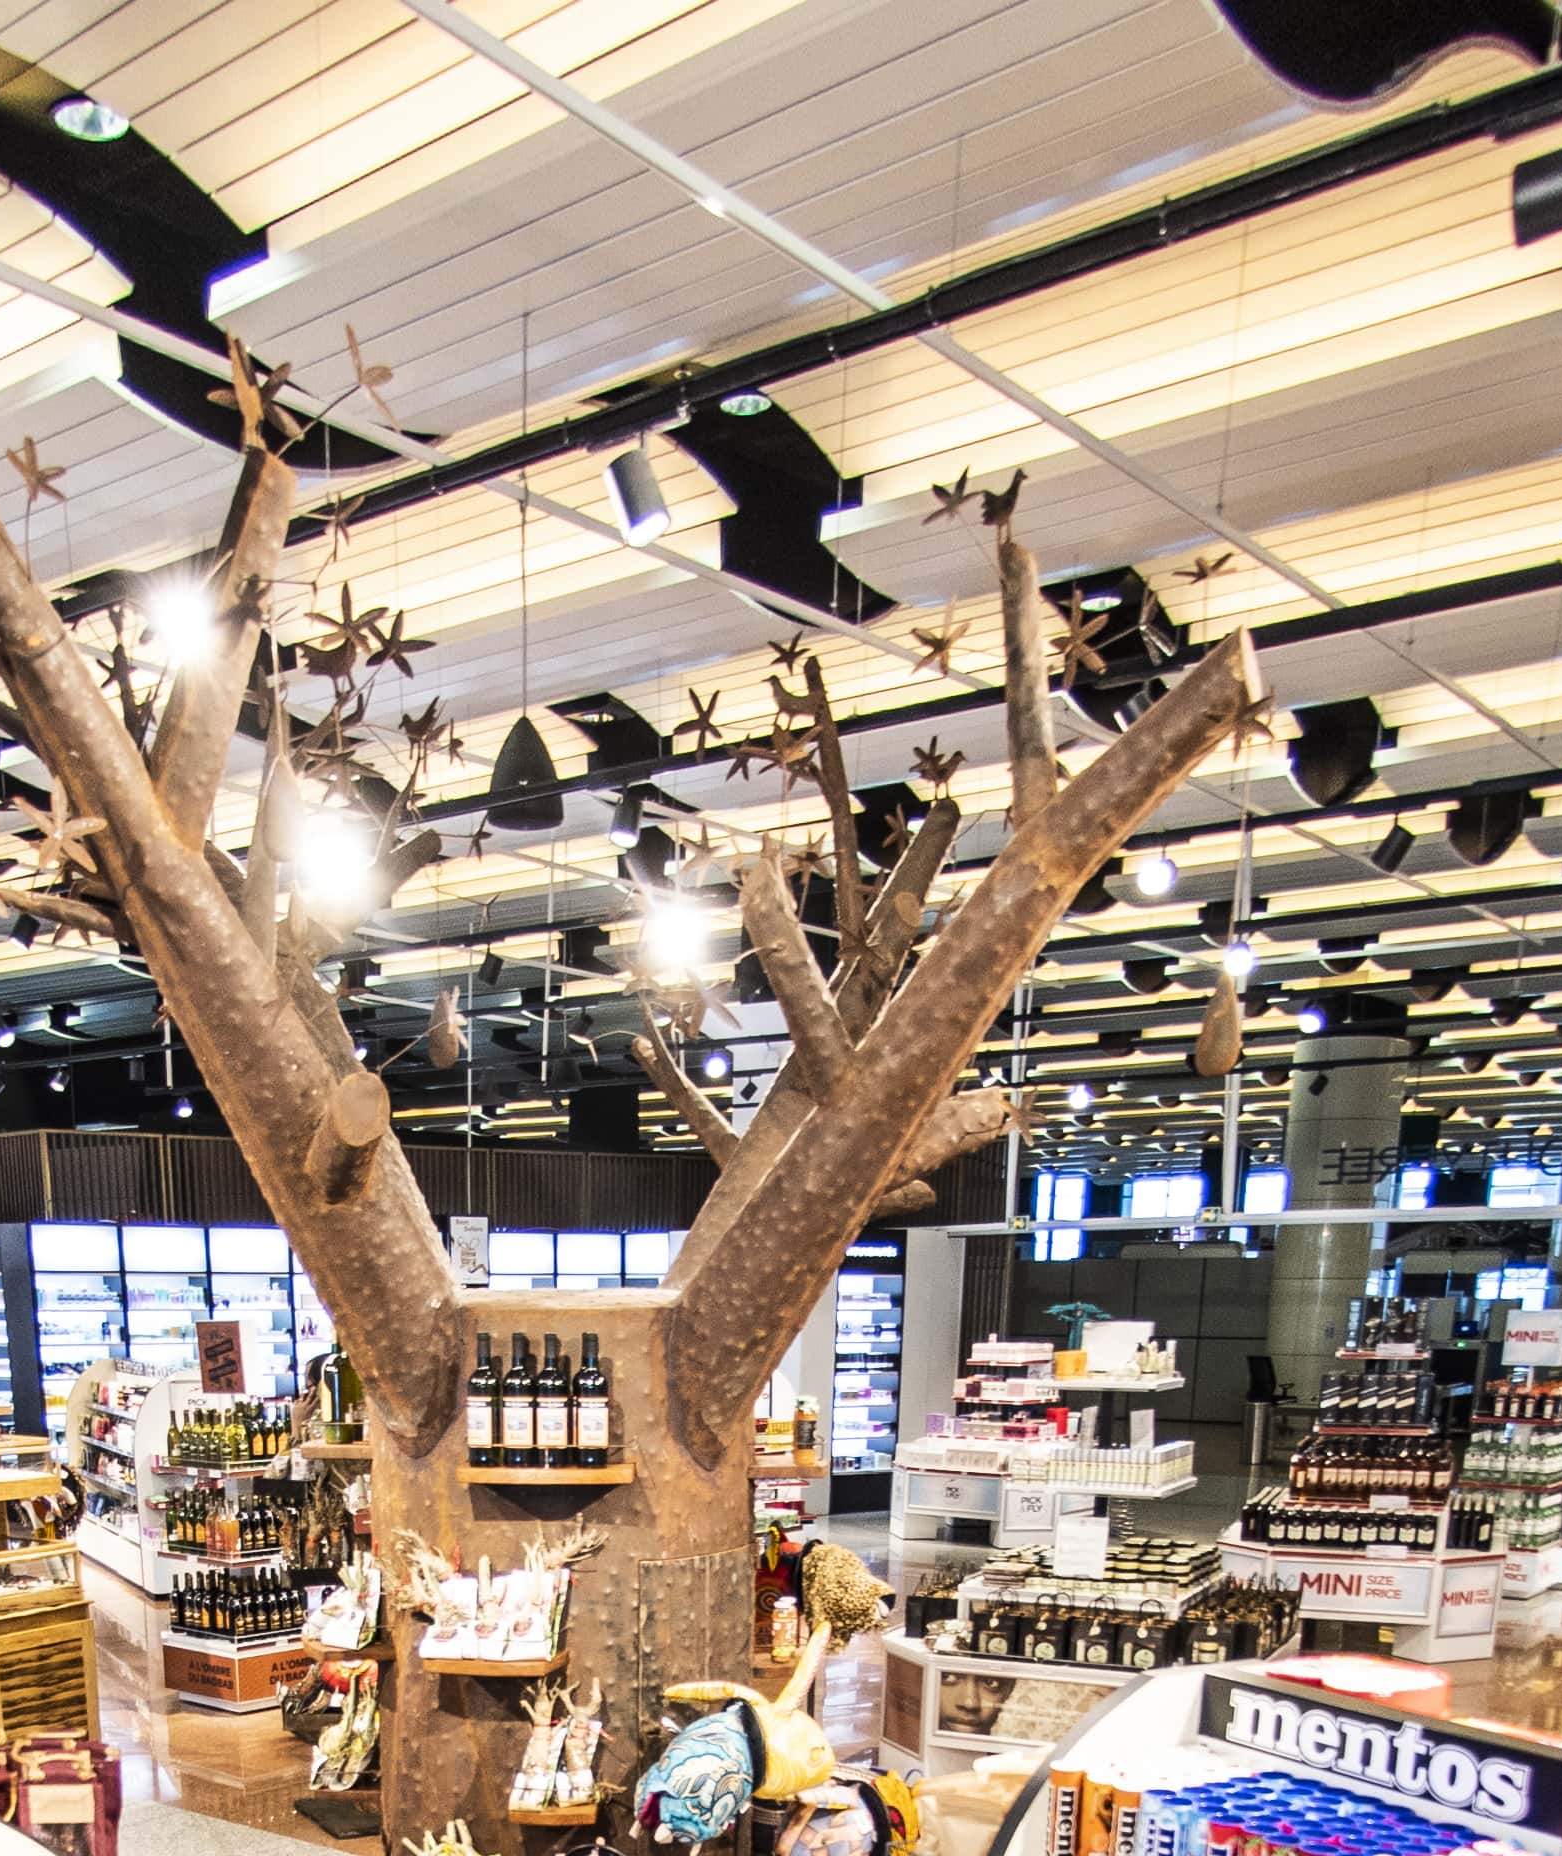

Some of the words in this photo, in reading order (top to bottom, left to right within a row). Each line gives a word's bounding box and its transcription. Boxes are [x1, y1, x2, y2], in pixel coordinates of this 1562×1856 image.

[1506, 1330, 1539, 1342] MINI
[1300, 1571, 1362, 1596] MINI
[1367, 1575, 1394, 1586] SIZE
[1365, 1587, 1403, 1600] PRICE
[1442, 1590, 1474, 1607] MINI
[1227, 1688, 1532, 1823] mentos
